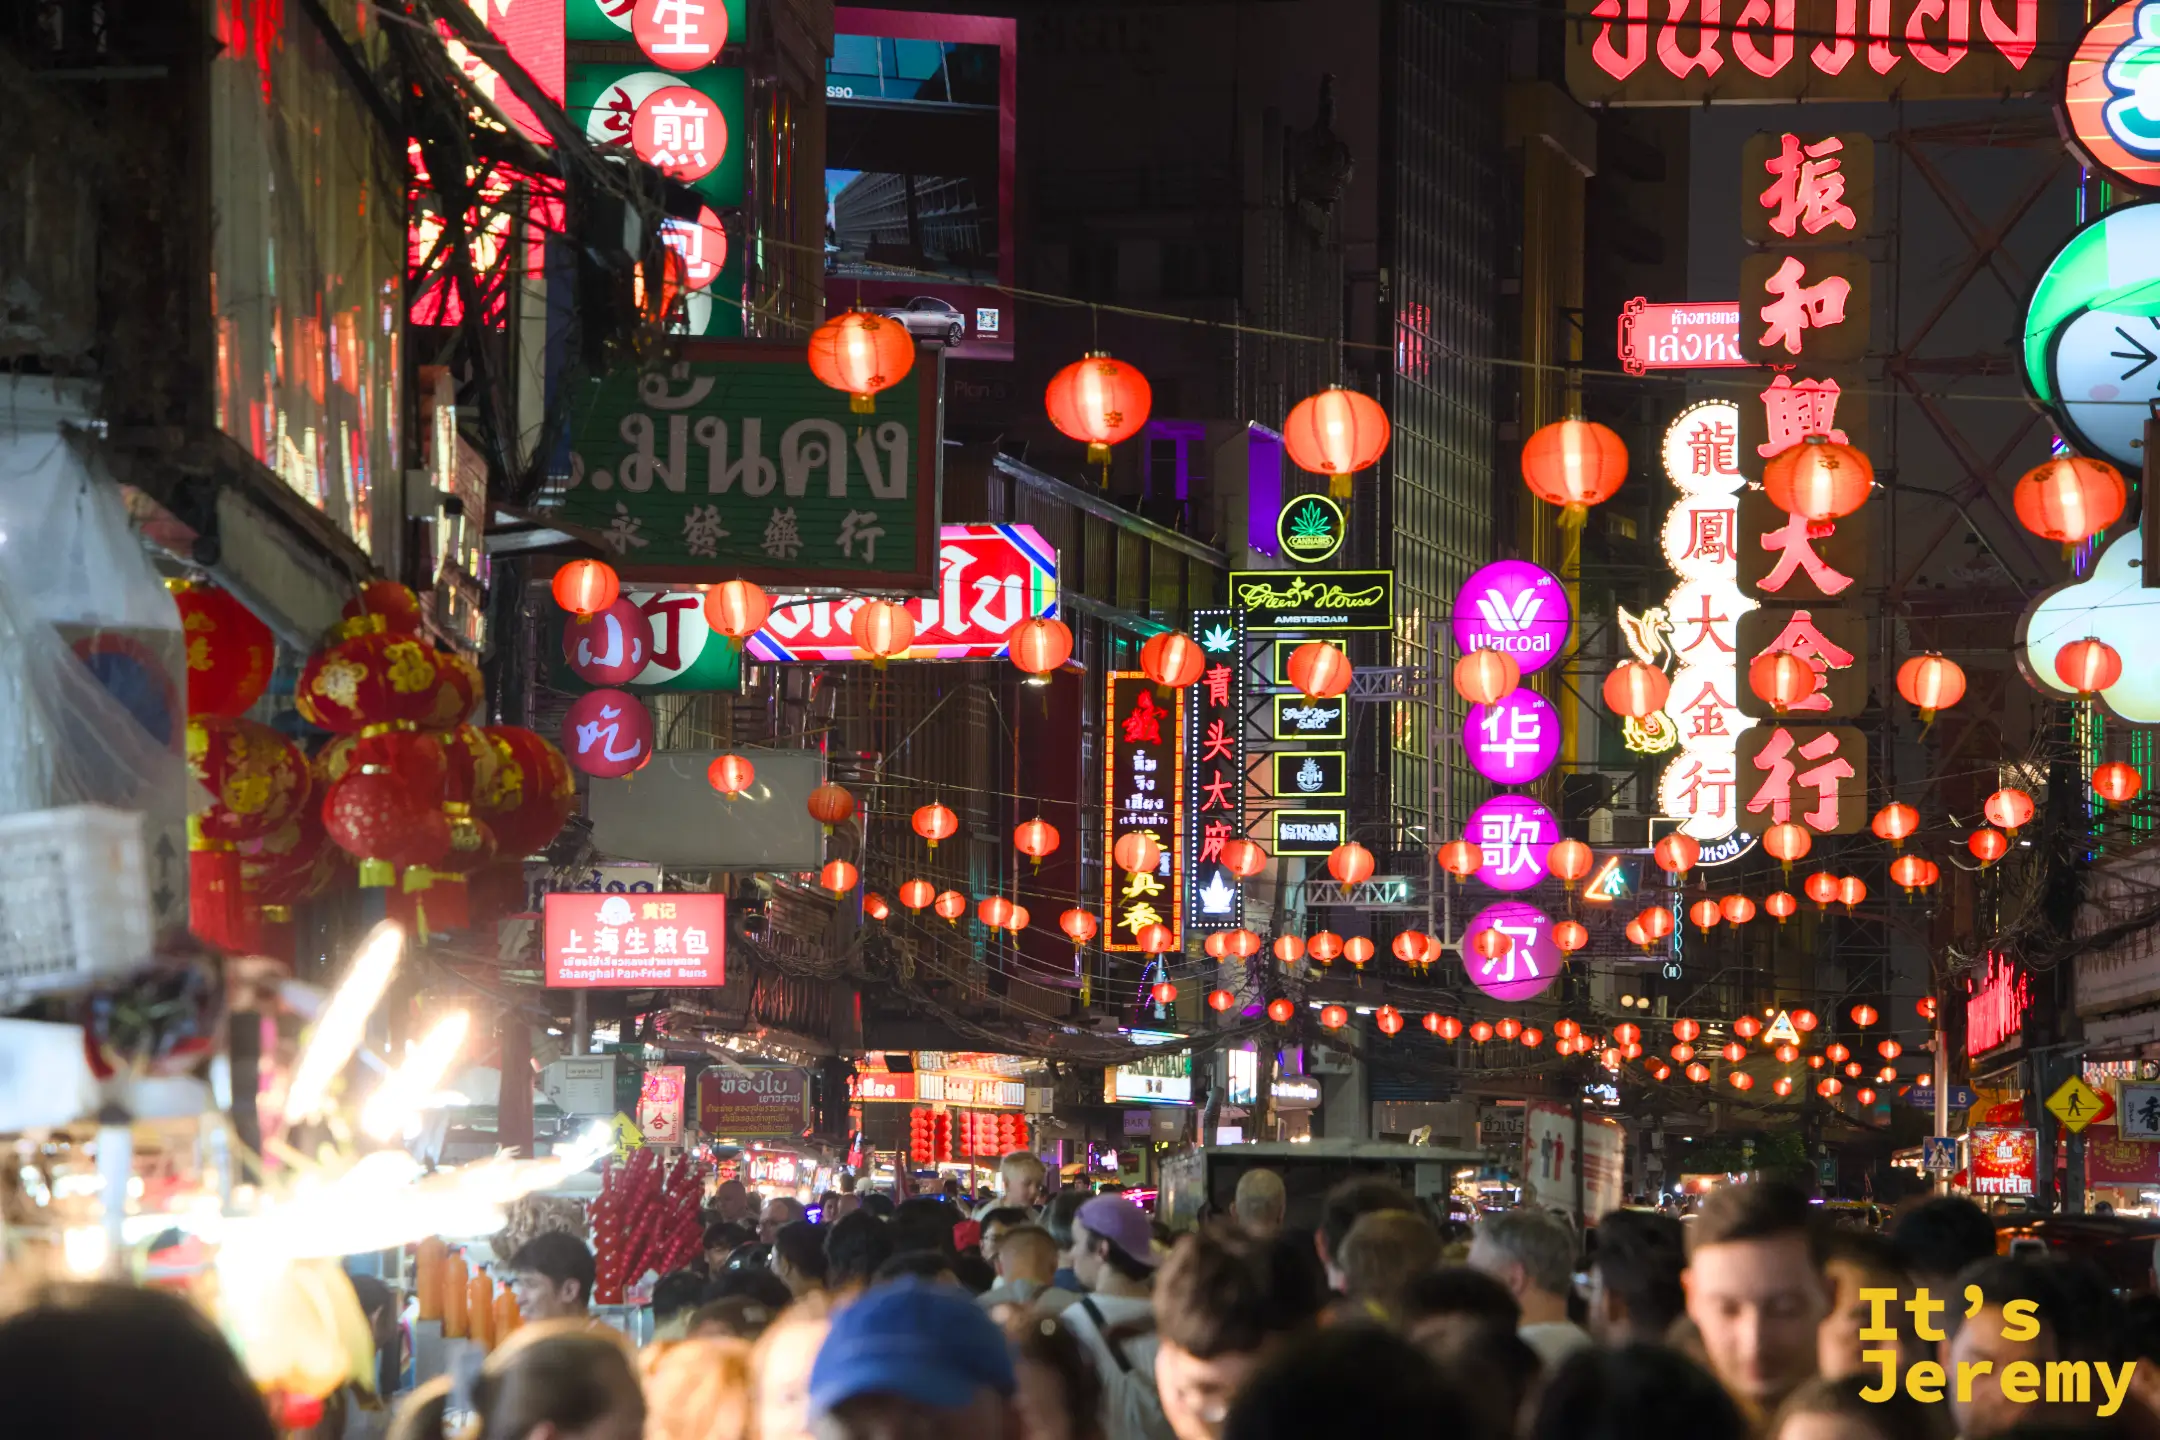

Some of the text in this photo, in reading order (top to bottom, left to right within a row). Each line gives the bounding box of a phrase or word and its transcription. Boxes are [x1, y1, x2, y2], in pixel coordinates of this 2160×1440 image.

[826, 86, 853, 98] S90
[1238, 583, 1384, 613] Green House
[1274, 615, 1349, 624] AMSTERDAM
[560, 925, 710, 955] 上海生煎包
[559, 968, 615, 981] Shanghai
[678, 968, 708, 978] Buns
